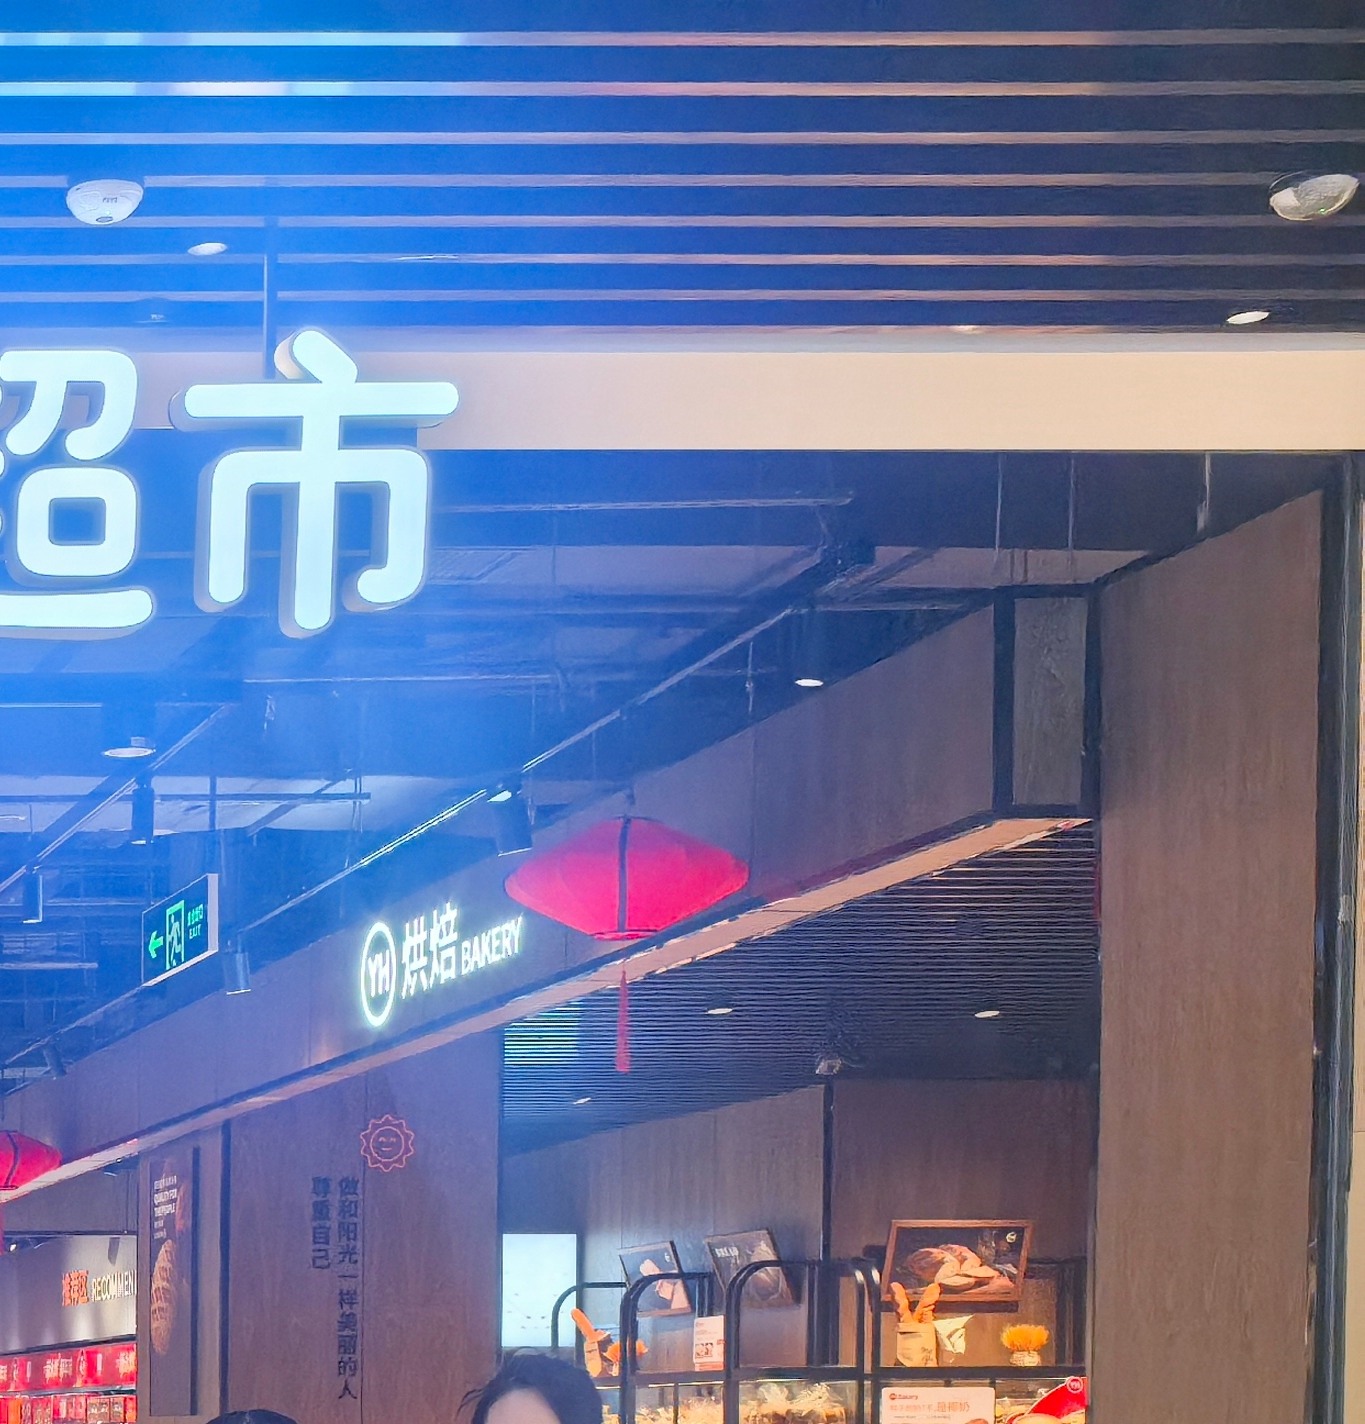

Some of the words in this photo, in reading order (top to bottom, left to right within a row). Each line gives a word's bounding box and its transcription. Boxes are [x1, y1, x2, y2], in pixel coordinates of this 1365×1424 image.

[368, 949, 390, 988] YH
[401, 901, 458, 1000] 烘焙
[461, 915, 523, 976] BAKERY
[312, 1176, 331, 1269] 尊重自己
[91, 1270, 137, 1303] RECOMMEN
